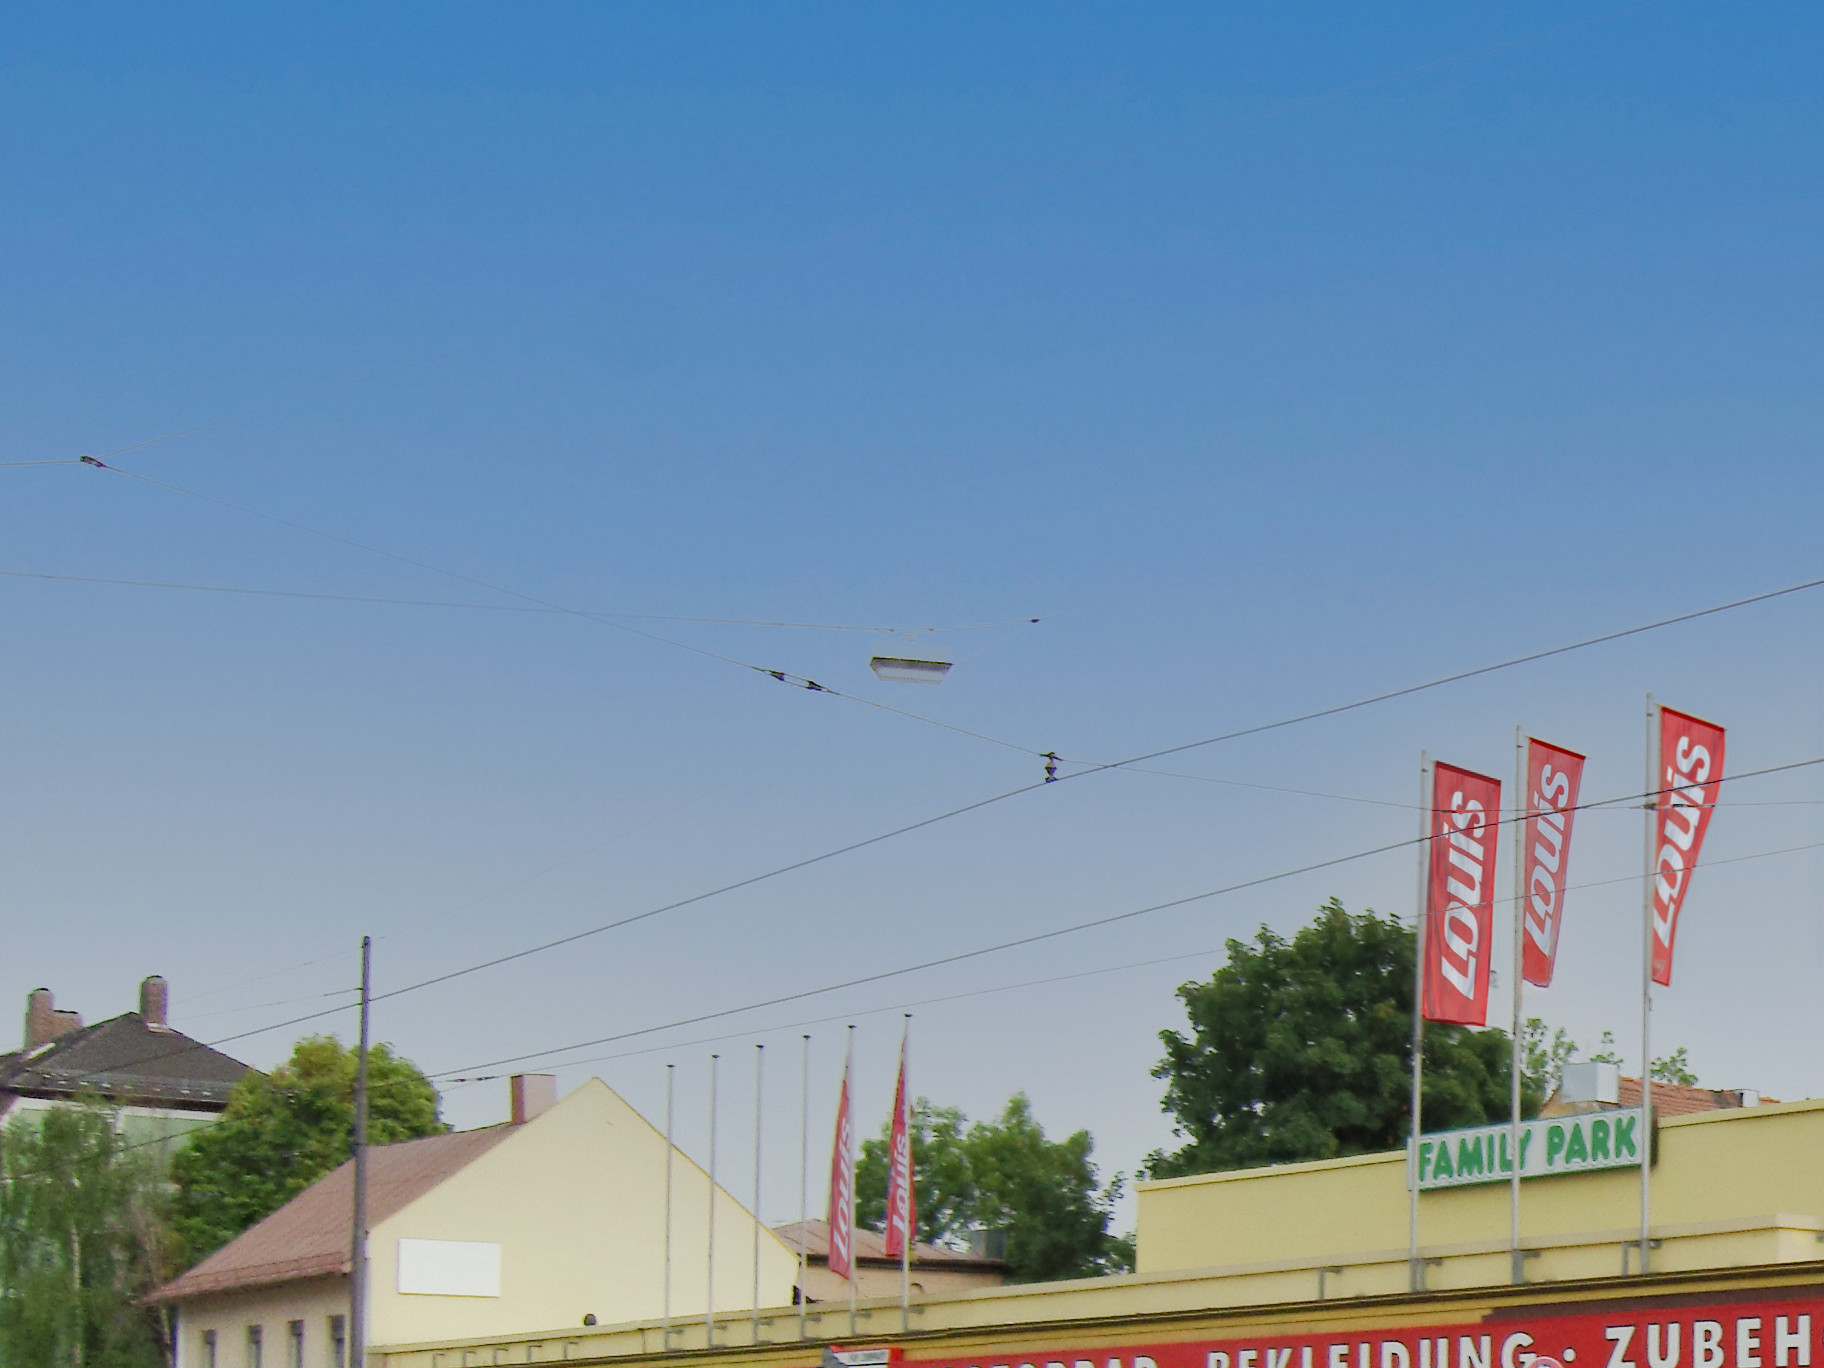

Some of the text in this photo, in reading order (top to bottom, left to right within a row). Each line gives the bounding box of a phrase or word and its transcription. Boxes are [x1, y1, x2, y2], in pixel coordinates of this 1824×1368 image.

[1441, 791, 1486, 1001] Louis
[1524, 763, 1570, 957] Louis
[1650, 735, 1711, 949] Louis
[1418, 1115, 1636, 1182] FAMILY PARK
